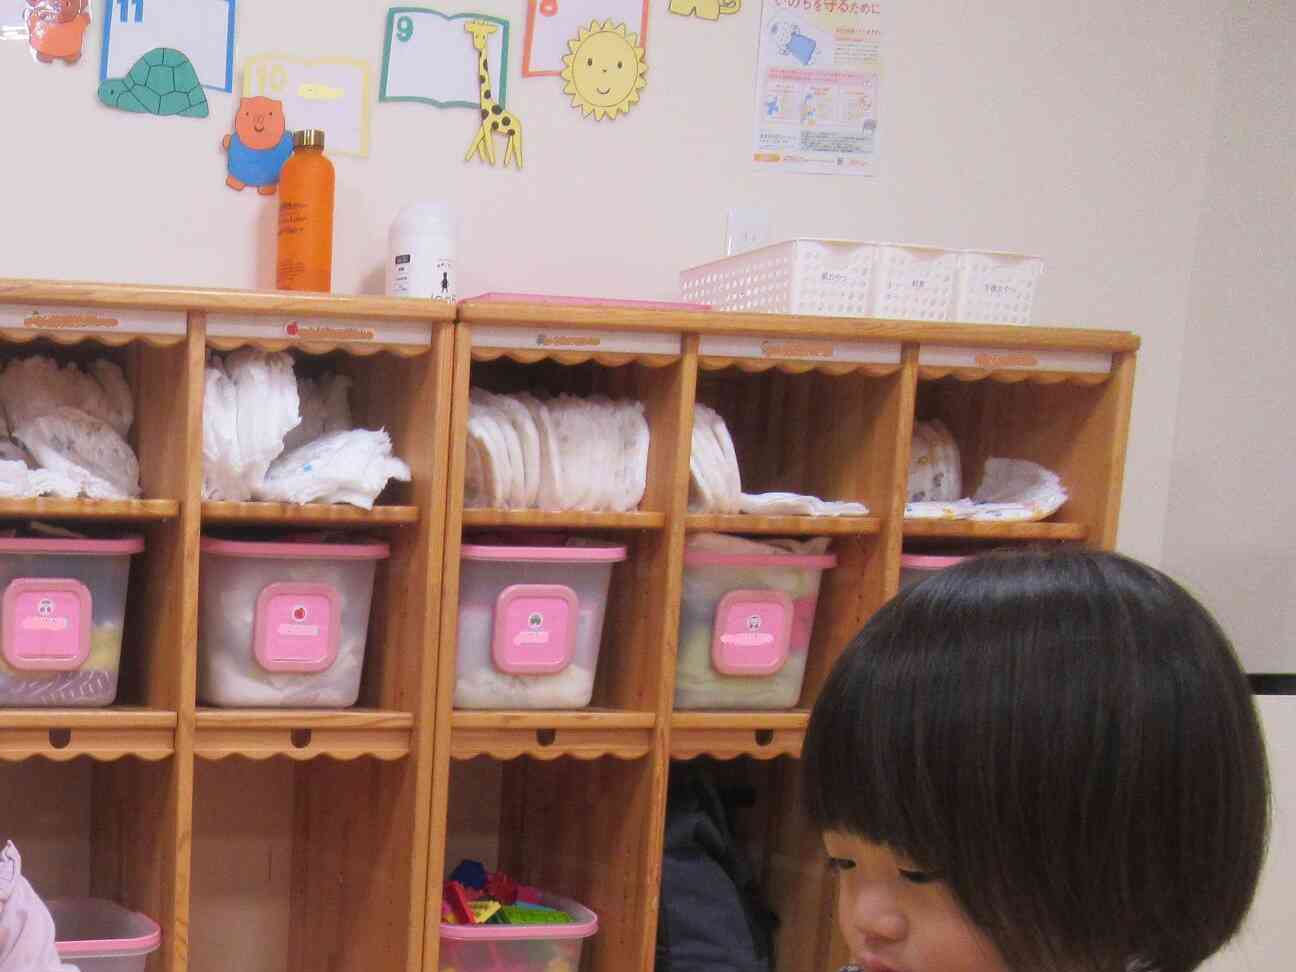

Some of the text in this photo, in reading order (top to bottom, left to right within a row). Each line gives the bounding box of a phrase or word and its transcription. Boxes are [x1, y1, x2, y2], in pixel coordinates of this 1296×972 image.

[116, 0, 145, 23] 11
[396, 16, 414, 42] 9
[255, 63, 290, 92] 10
